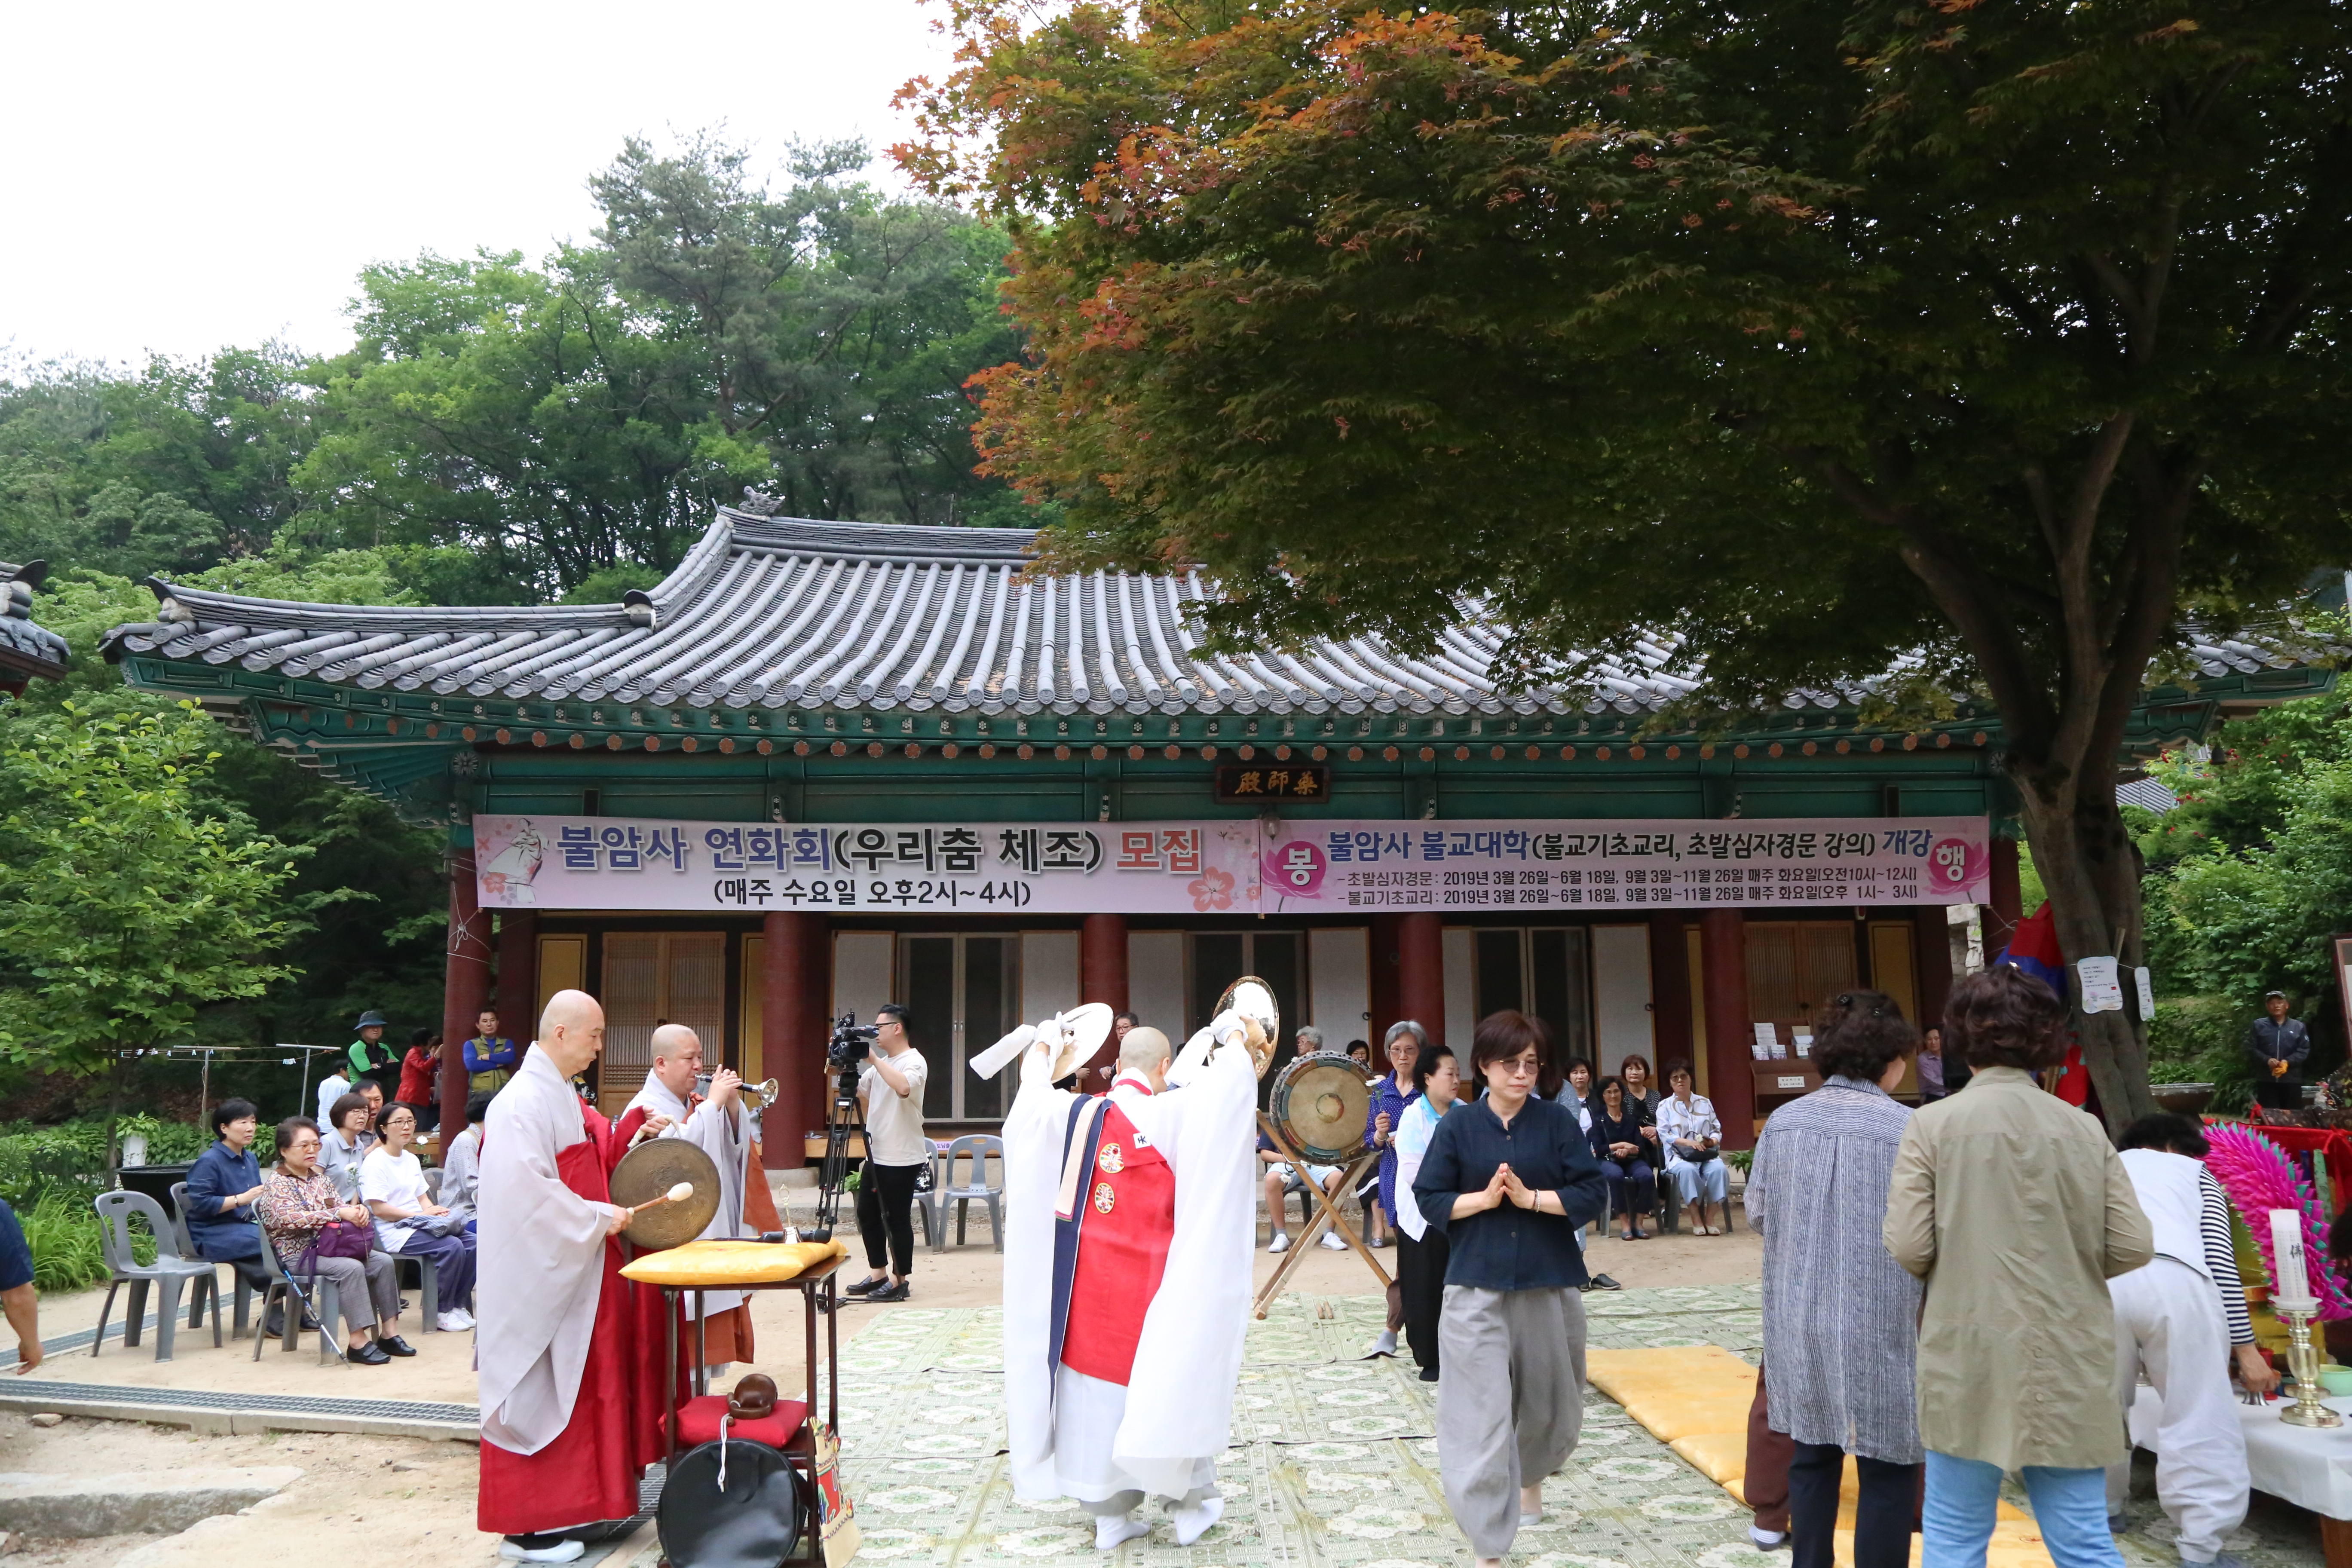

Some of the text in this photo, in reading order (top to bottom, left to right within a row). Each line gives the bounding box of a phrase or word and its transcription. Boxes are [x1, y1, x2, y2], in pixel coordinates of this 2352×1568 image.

[556, 826, 1200, 873] 불암사 연화회(우리춤 체조) 모집
[1326, 829, 1934, 862] 불암사 불교대학(불교기초교리, 초발심자경문 강의) 개강
[1282, 848, 1318, 886] 봉
[1443, 871, 1489, 885] 2019년
[1492, 870, 1515, 885] 3월
[1519, 870, 1582, 885] 26일~6월
[1586, 870, 1619, 885] 18일,
[1625, 870, 1646, 884] 9월
[1650, 869, 1711, 883] 3일~11월
[1715, 869, 1743, 882] 26일
[1748, 868, 1774, 882] 매주
[1935, 844, 1966, 882] 행
[714, 878, 1031, 907] (매주 수요일 오후2시~4시)
[1443, 889, 1489, 904] 2019년
[1493, 889, 1515, 904] 3월
[1519, 888, 1582, 903] 26일~6월
[1587, 888, 1620, 903] 18일,
[1626, 888, 1647, 902] 9월
[1651, 887, 1711, 902] 3일~11월
[1715, 886, 1744, 900] 26일
[1748, 886, 1774, 900] 매주
